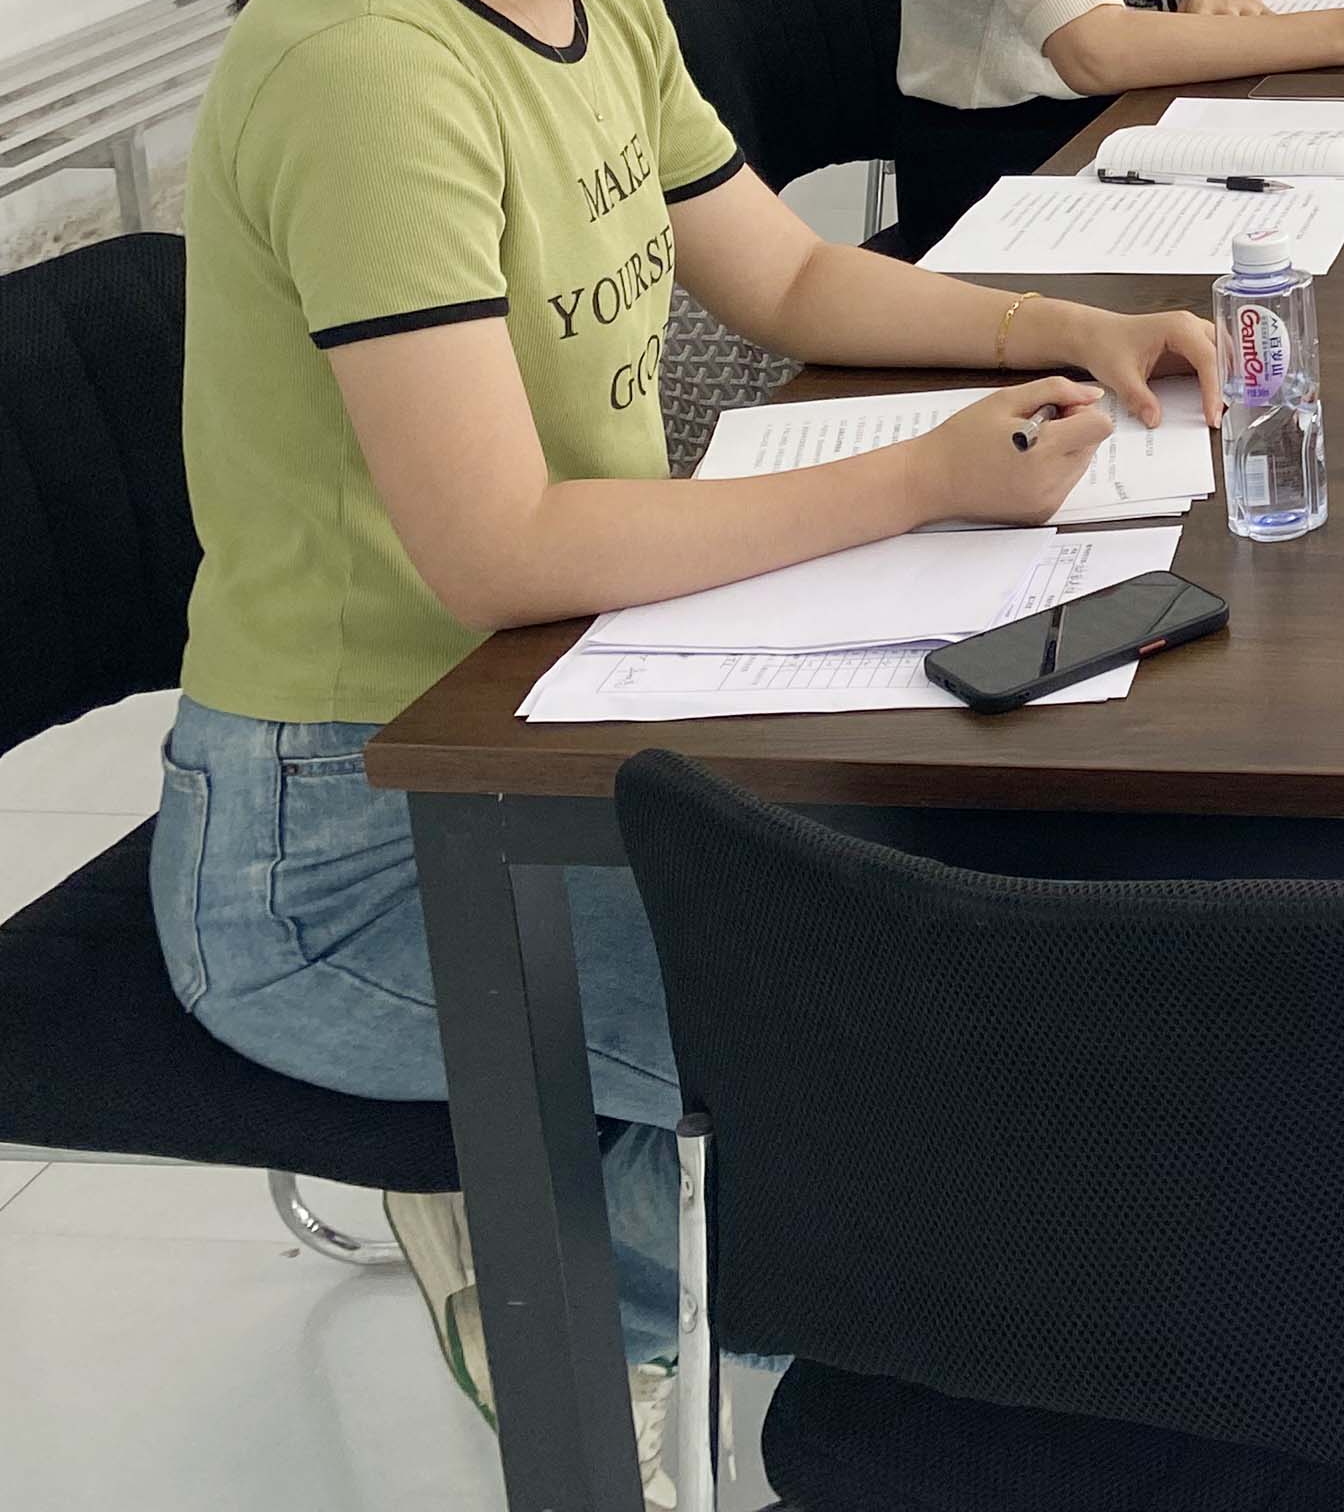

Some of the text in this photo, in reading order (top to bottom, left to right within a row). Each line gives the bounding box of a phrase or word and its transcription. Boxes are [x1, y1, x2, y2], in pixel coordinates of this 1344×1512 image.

[576, 133, 652, 223] MAKE
[1270, 336, 1284, 377] 百岁山
